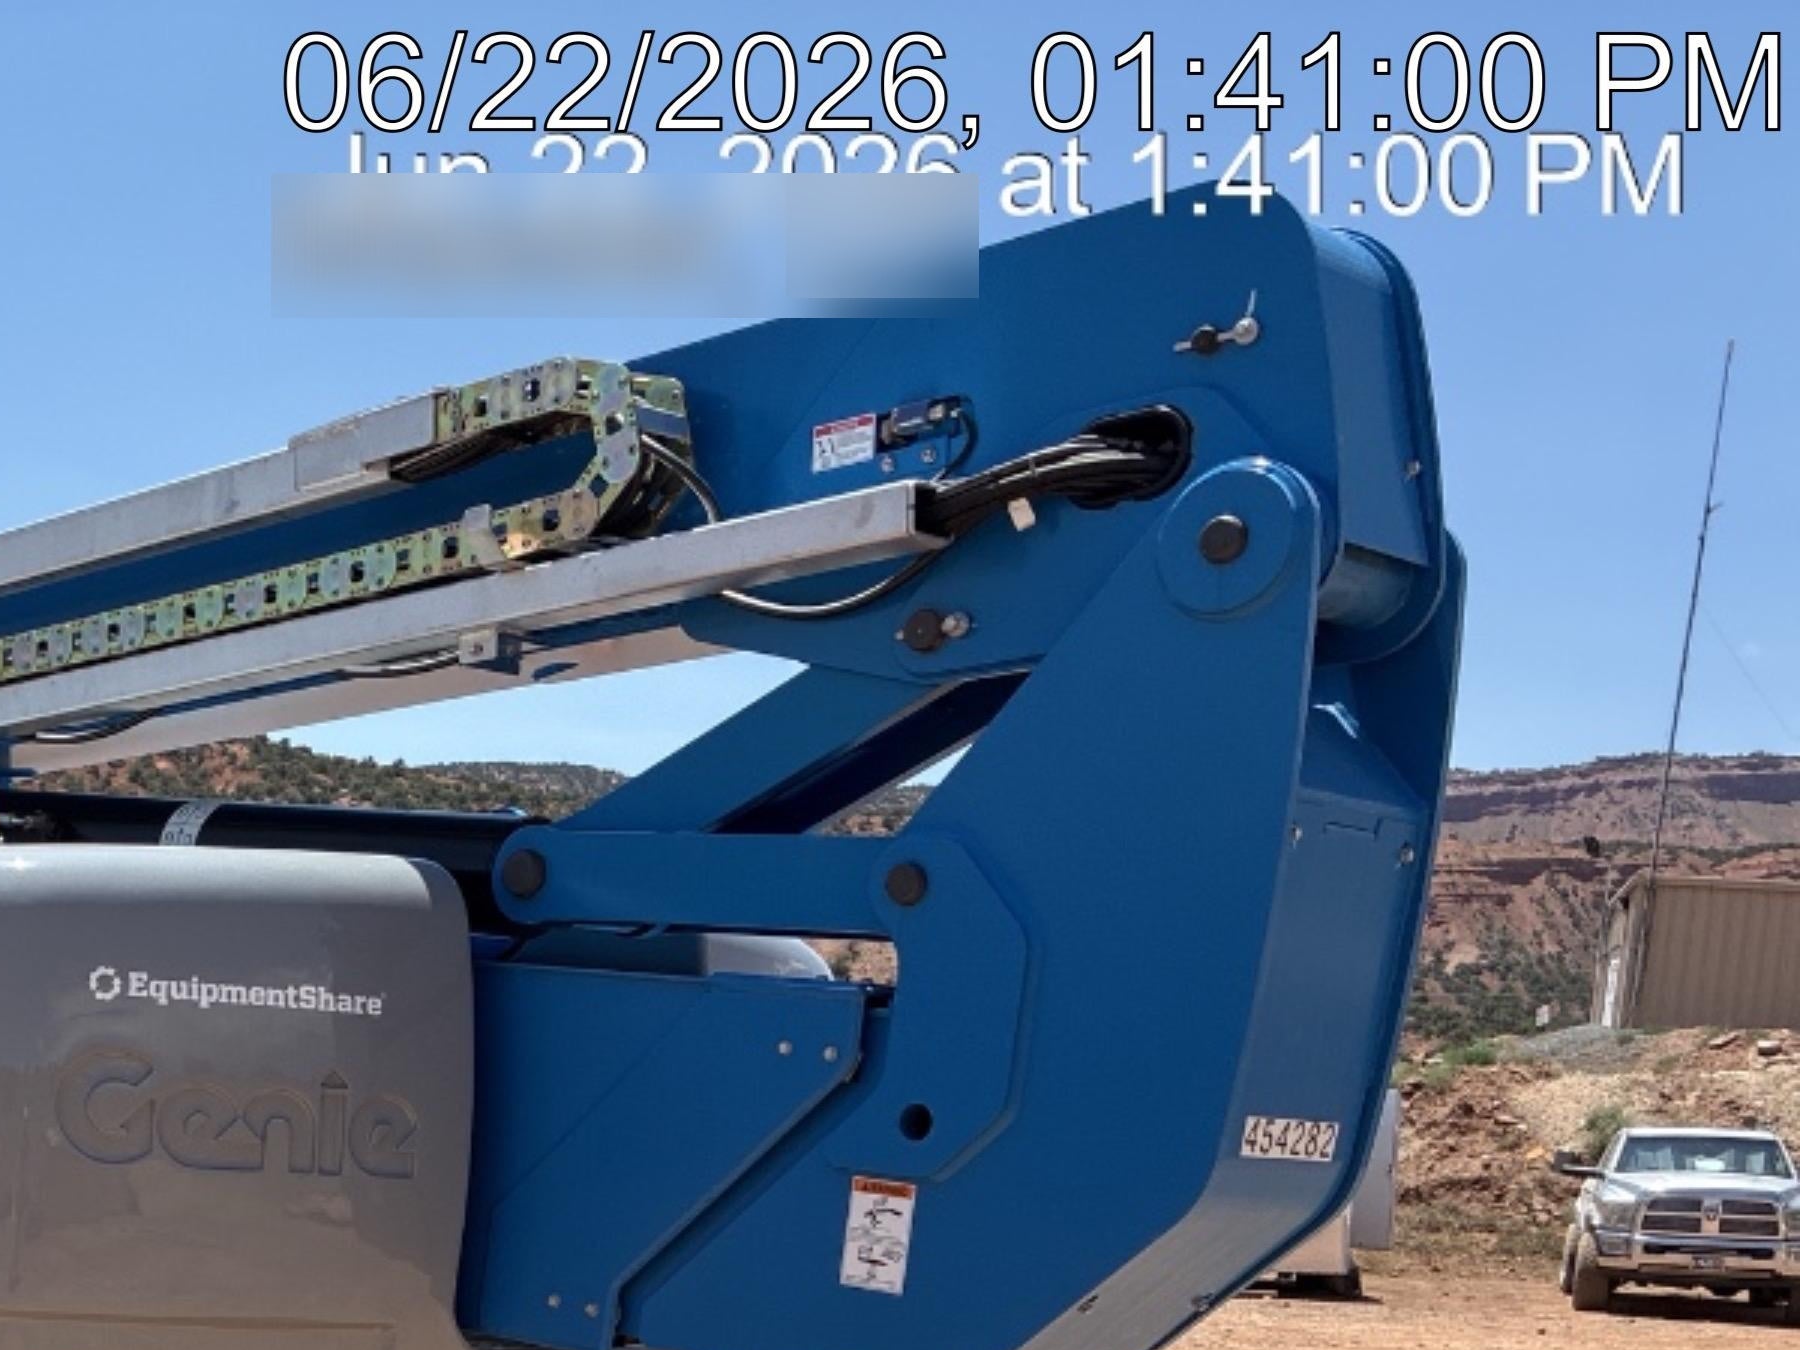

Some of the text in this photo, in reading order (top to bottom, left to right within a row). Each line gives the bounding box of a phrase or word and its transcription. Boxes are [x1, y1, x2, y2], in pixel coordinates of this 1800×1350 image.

[127, 970, 383, 1016] EquipmentShare
[54, 1047, 418, 1179] Genie
[1244, 1118, 1336, 1158] 454282
